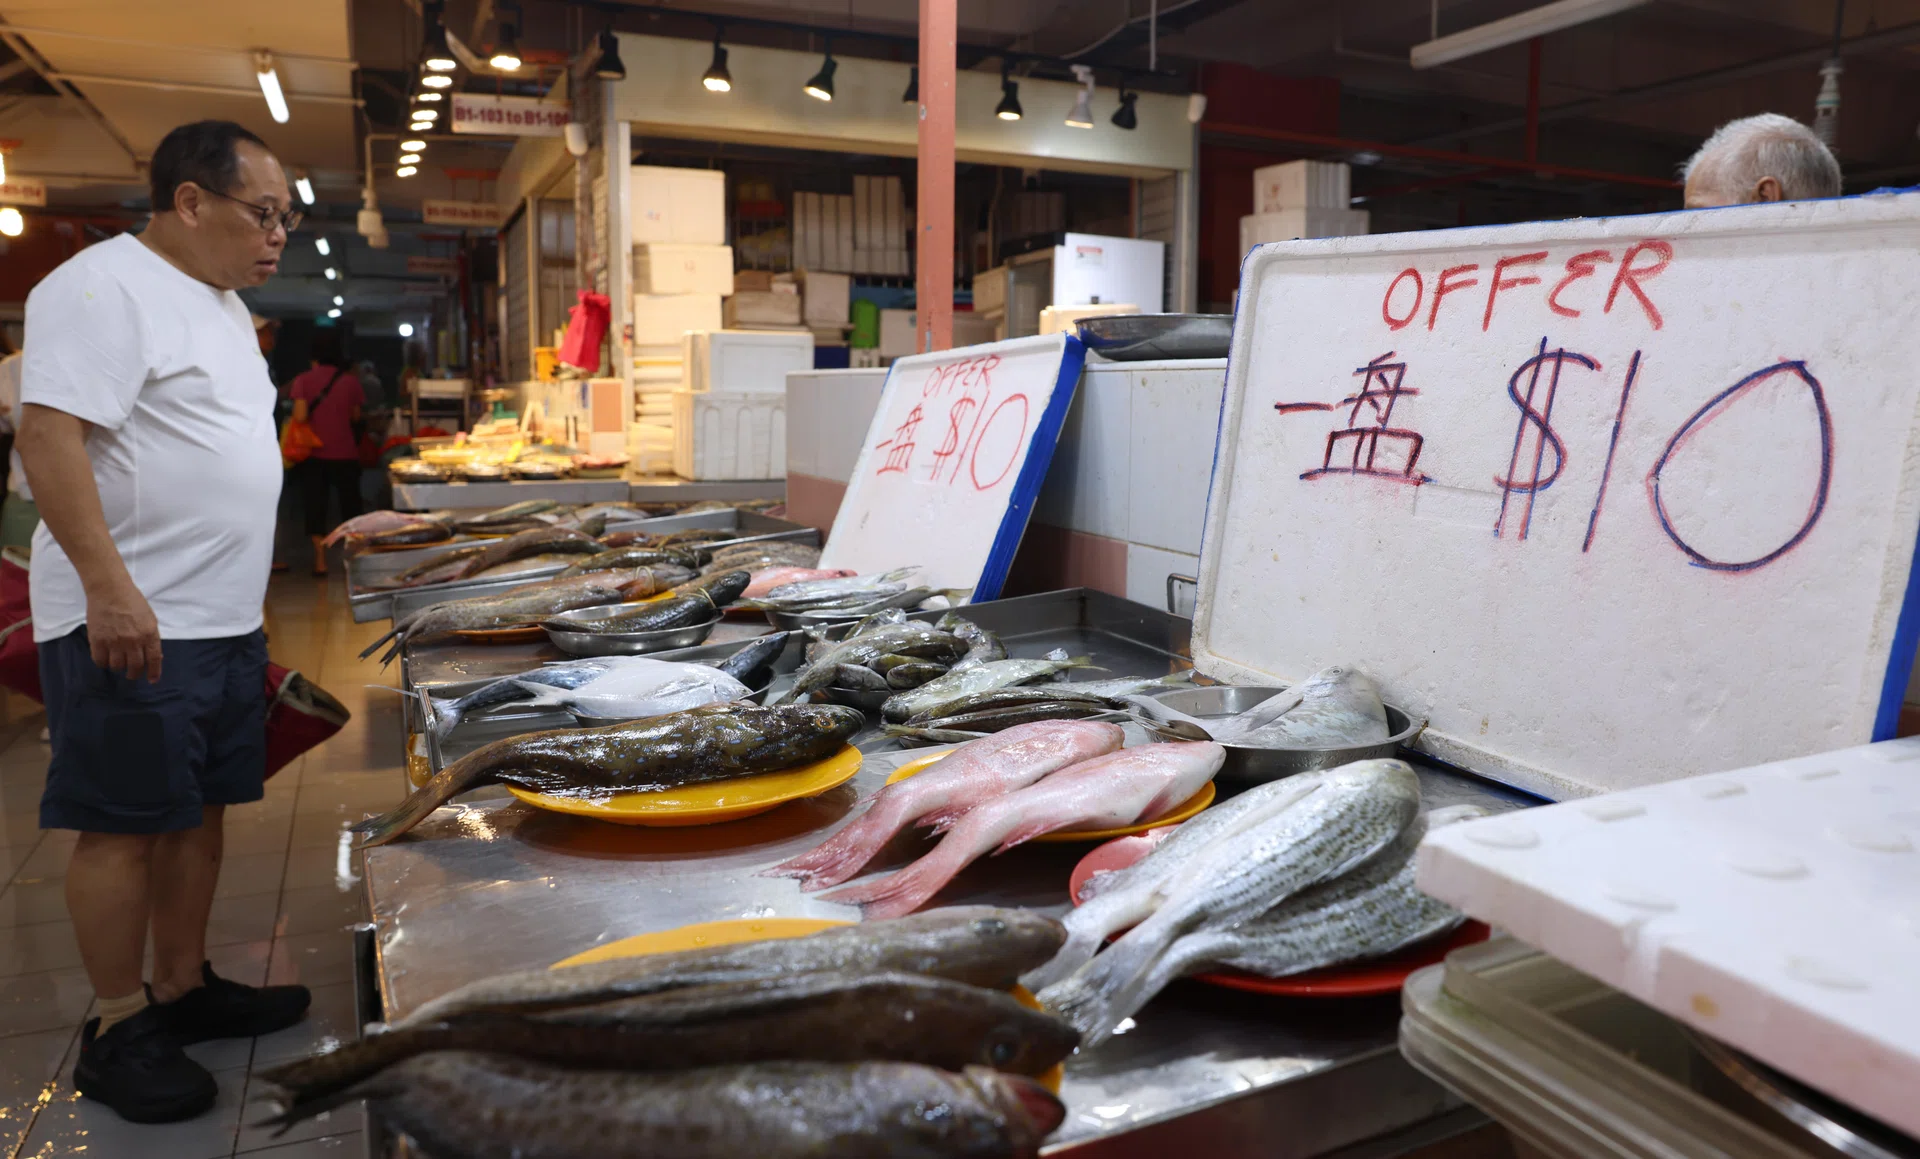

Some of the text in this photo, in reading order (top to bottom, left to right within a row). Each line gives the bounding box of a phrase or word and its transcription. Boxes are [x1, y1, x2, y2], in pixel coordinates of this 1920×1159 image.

[455, 106, 504, 124] B1-103
[506, 110, 522, 125] to
[1382, 239, 1675, 331] OFFER
[923, 353, 1001, 398] OFFER
[930, 391, 1029, 492] $10
[1492, 335, 1834, 573] $10
